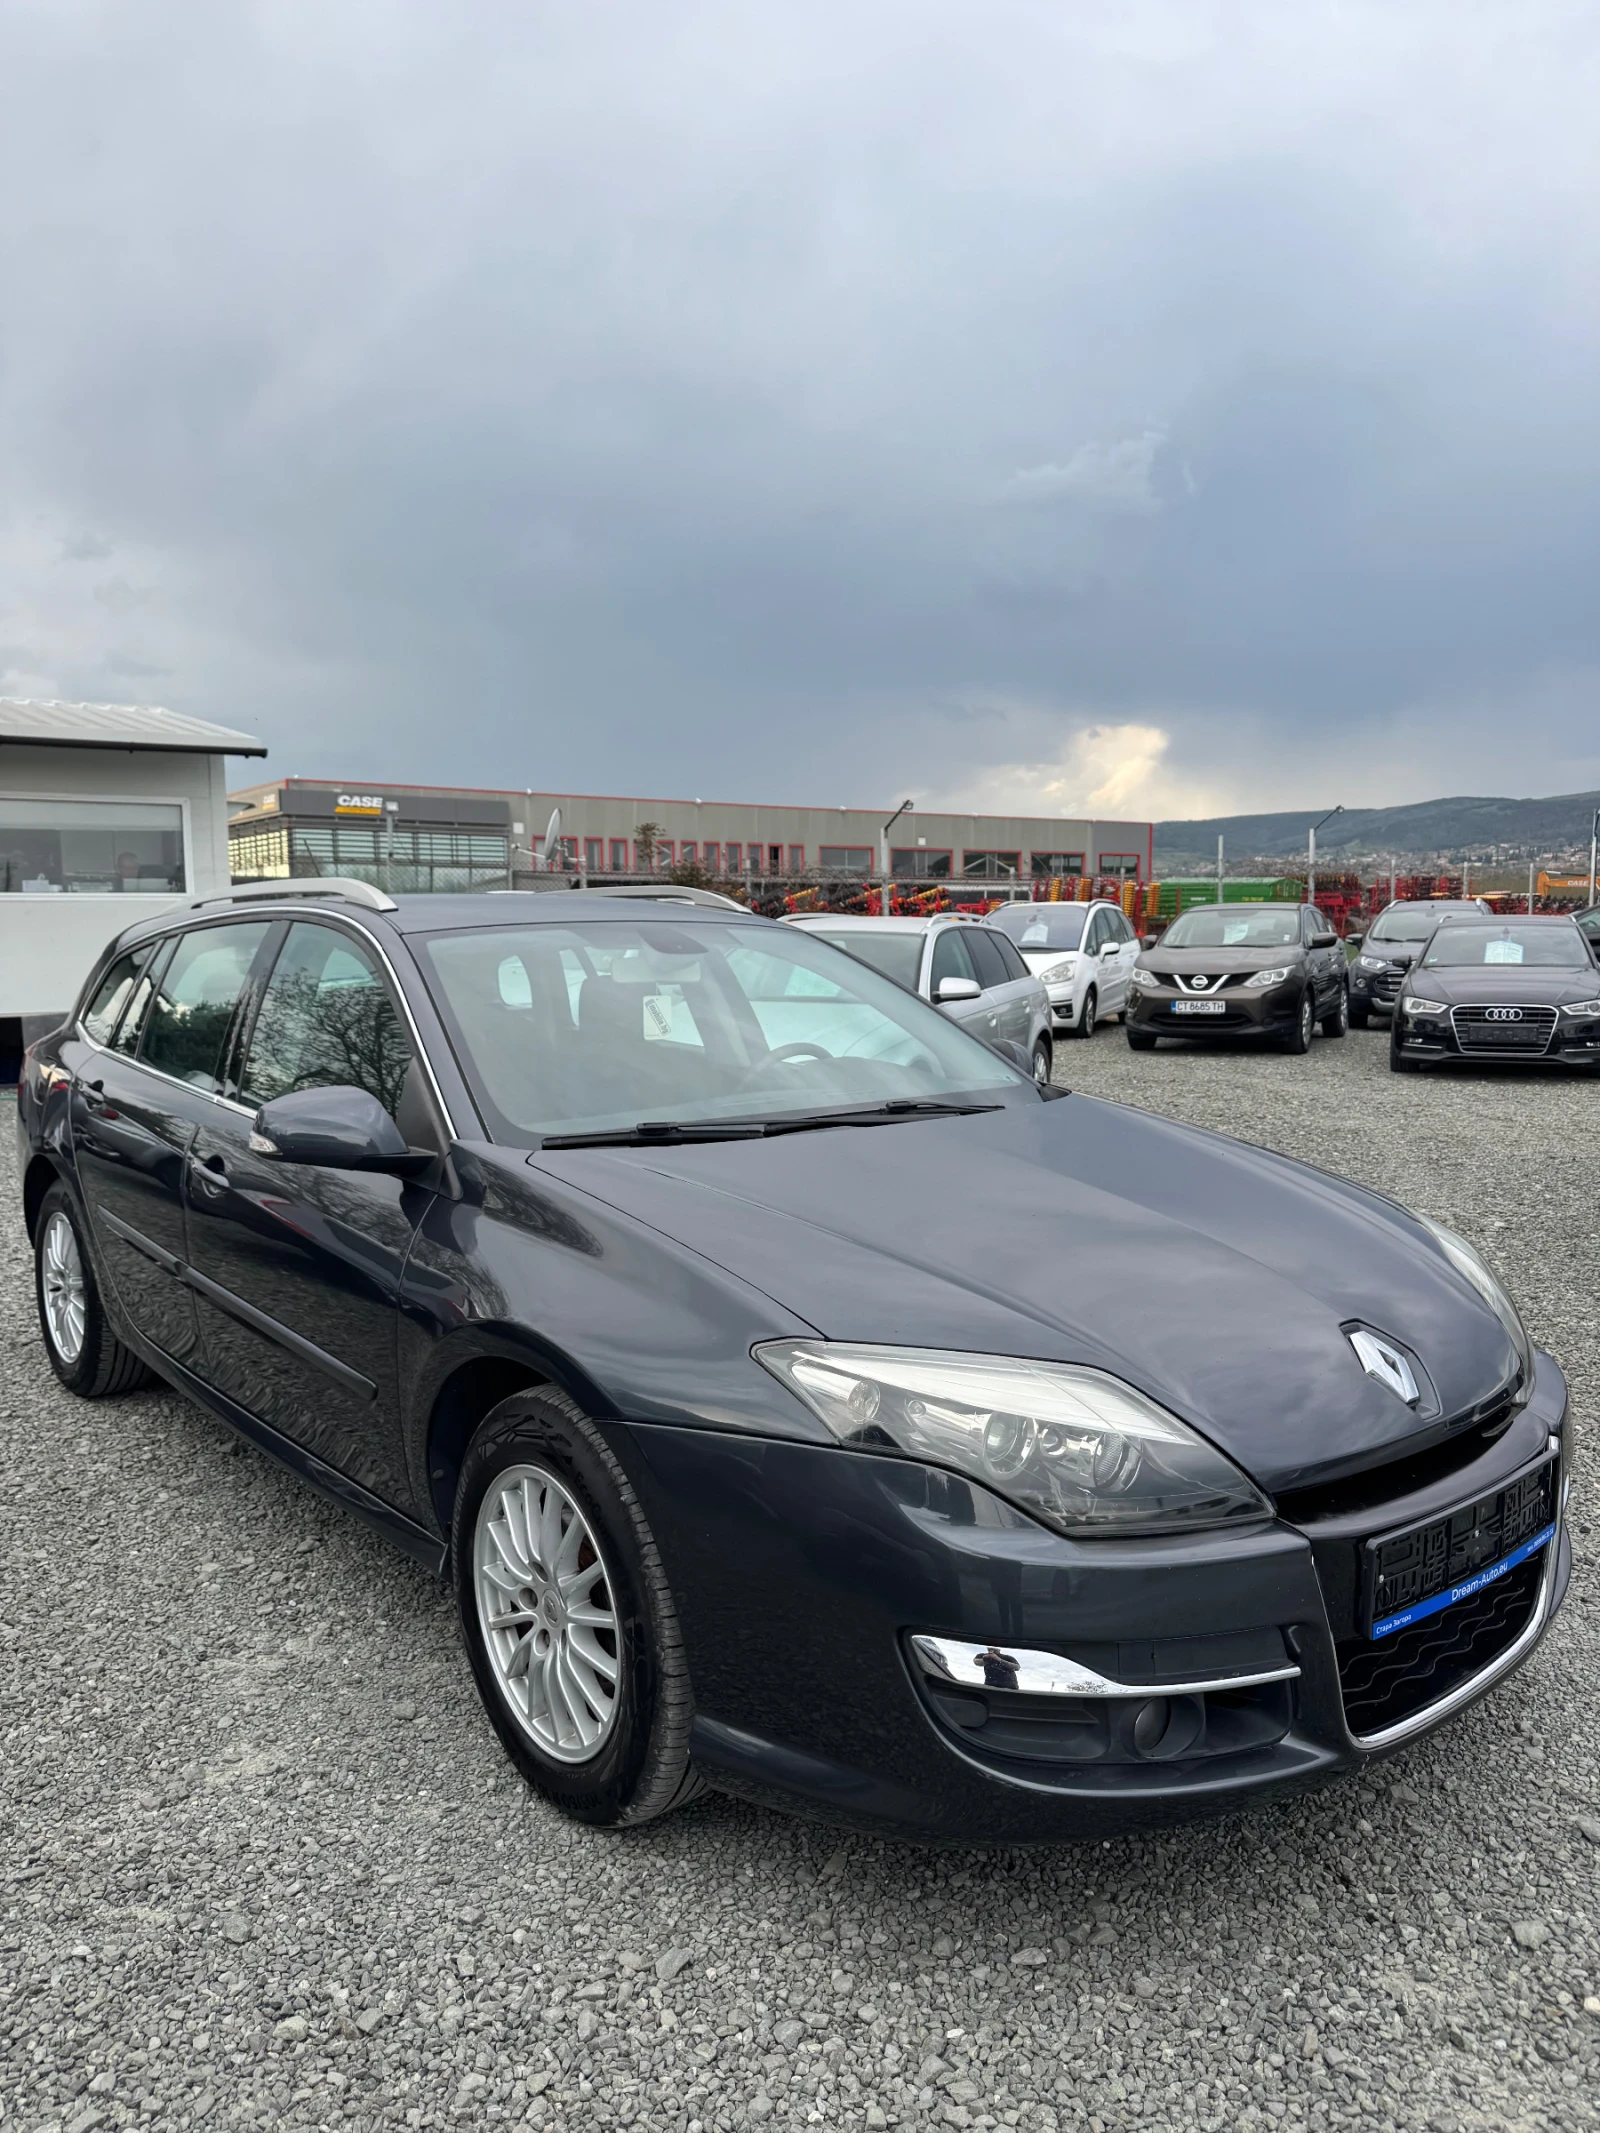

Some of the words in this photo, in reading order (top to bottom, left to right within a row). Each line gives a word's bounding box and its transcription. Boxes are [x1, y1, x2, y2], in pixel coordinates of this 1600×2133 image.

[337, 795, 383, 808] CASE
[1567, 880, 1589, 888] CASE
[1190, 1002, 1210, 1011] 8685
[1451, 1561, 1508, 1601] Dream-Auto.eu
[1376, 1623, 1392, 1635] Стара
[1393, 1614, 1412, 1627] Загора
